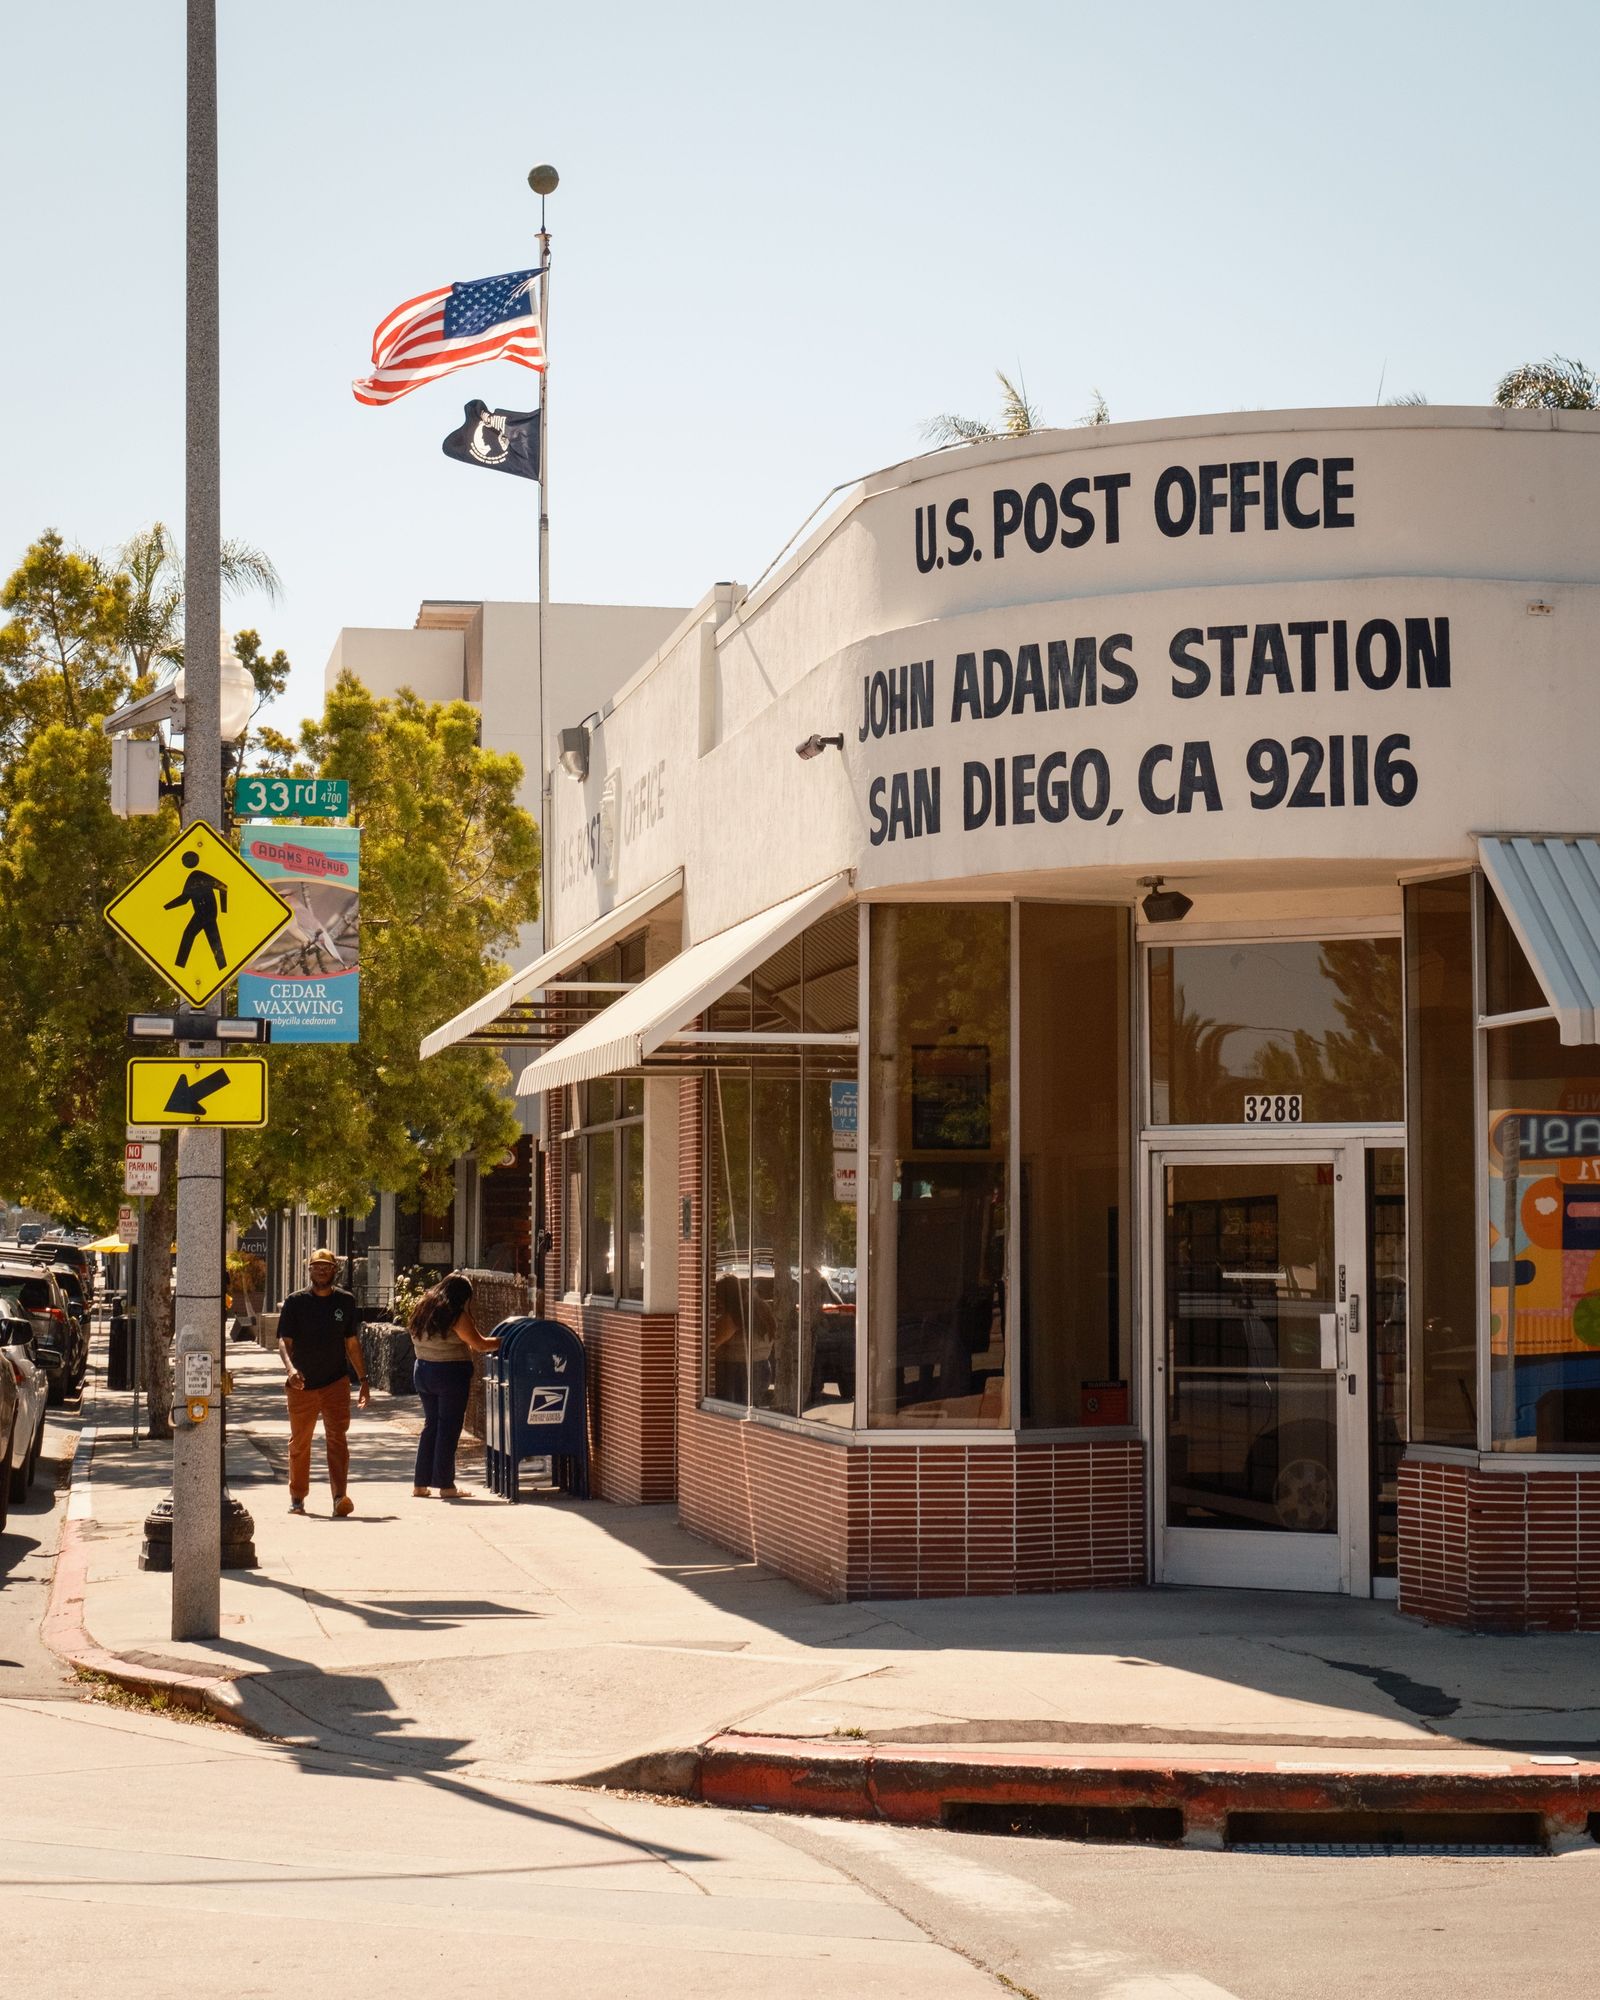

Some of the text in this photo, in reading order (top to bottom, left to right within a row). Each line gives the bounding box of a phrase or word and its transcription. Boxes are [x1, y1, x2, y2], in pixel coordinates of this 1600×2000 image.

[915, 457, 1355, 574] U.S. POST OFFICE
[858, 617, 1451, 742] JOHN ADAMS STATION
[247, 781, 337, 812] 33rd ST
[320, 793, 342, 804] 4700
[624, 760, 666, 846] OFFICE
[869, 733, 1418, 846] SAN DIEGO, CA 92116
[258, 845, 302, 863] ADAMS
[307, 857, 345, 874] AVENUE
[270, 984, 327, 998] CEDAR
[253, 1000, 343, 1015] WAXWING
[267, 1016, 337, 1027] mbycilla cedrorum
[1246, 1095, 1300, 1122] 3288
[128, 1146, 140, 1158] NO
[128, 1162, 158, 1171] PARKING
